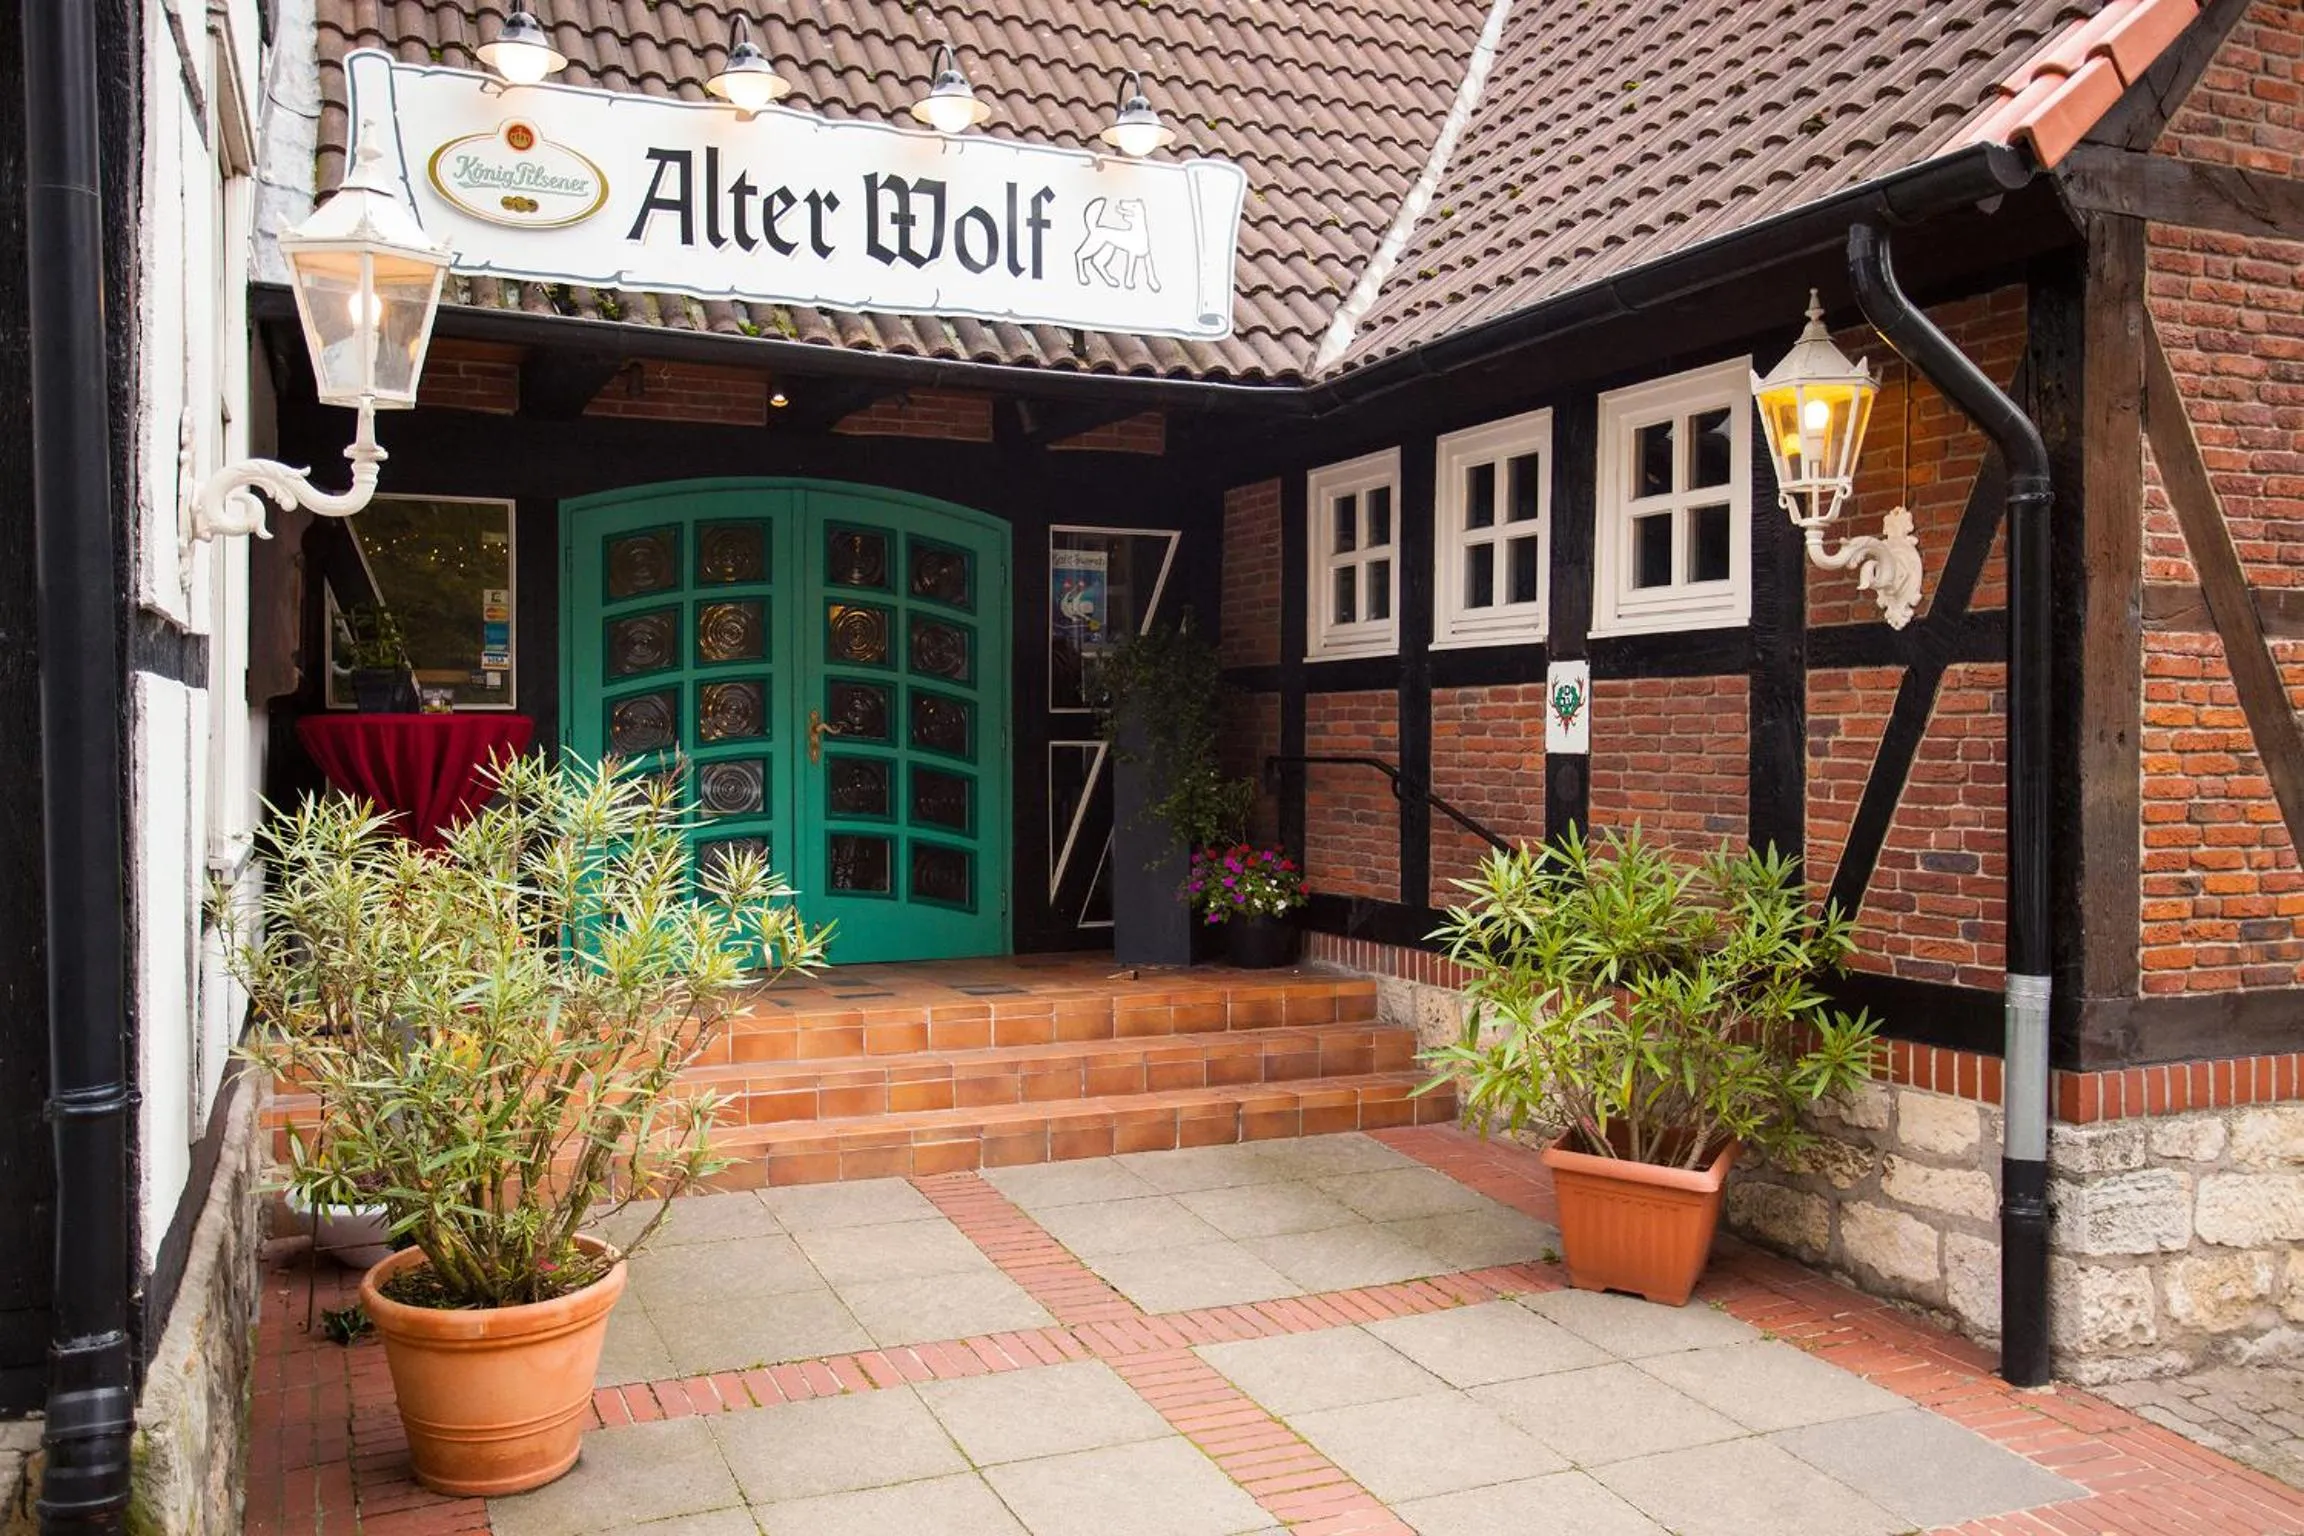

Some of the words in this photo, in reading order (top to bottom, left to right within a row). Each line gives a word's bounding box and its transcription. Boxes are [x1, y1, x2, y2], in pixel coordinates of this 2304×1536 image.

[453, 155, 515, 189] König
[513, 161, 590, 193] Pilsener
[626, 145, 841, 260] Alter
[862, 171, 1056, 280] Wolf
